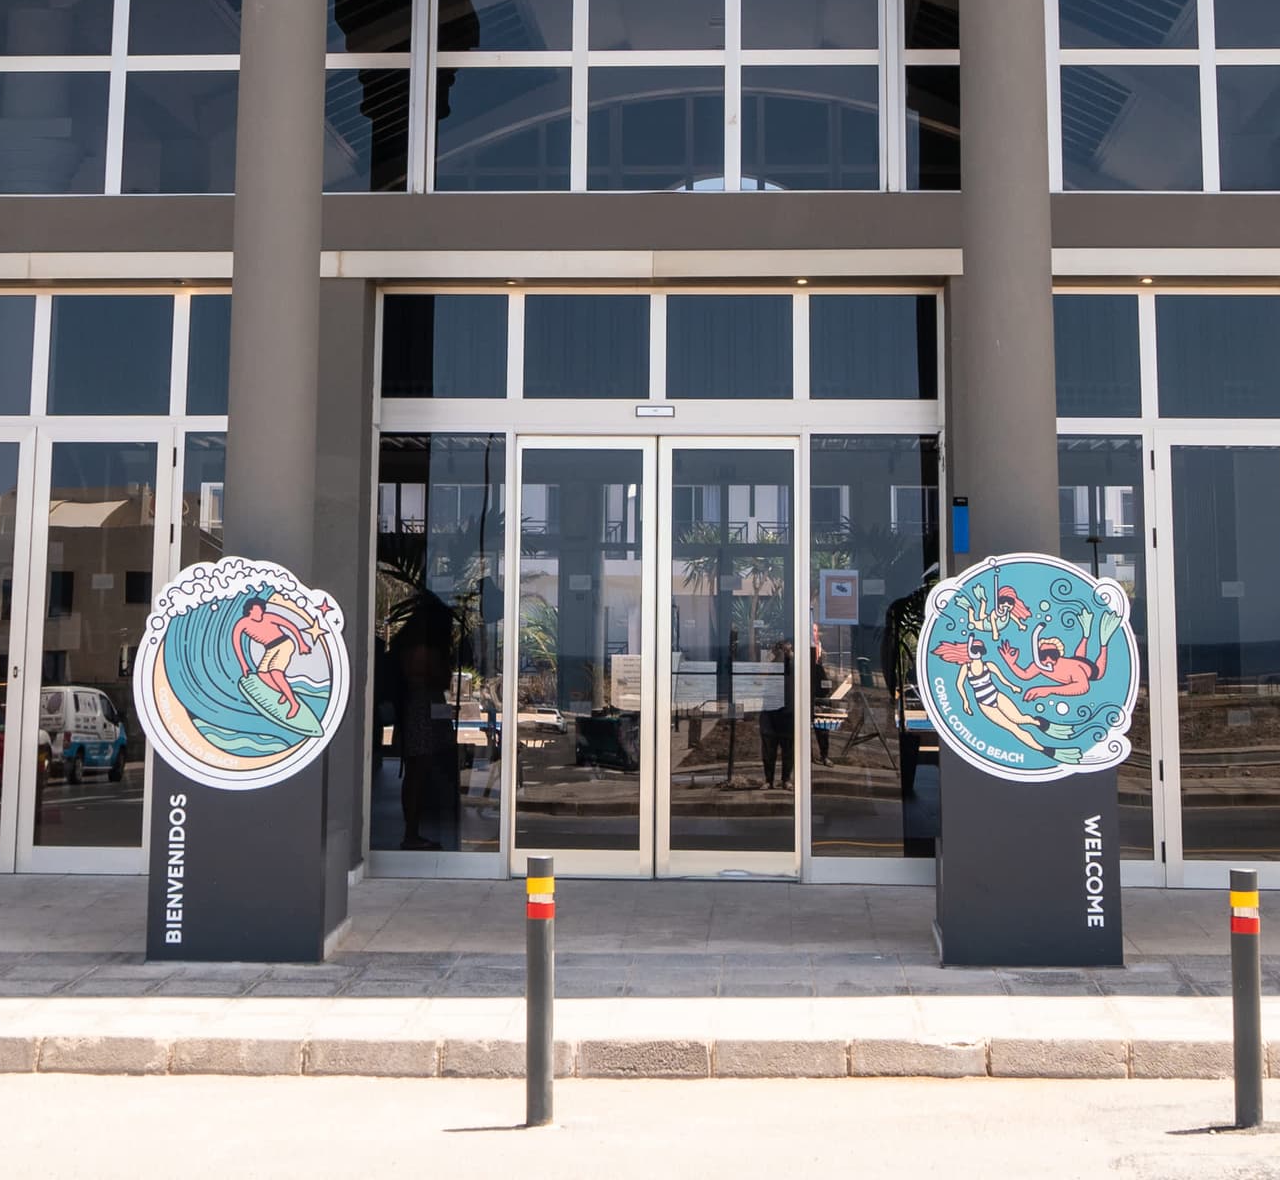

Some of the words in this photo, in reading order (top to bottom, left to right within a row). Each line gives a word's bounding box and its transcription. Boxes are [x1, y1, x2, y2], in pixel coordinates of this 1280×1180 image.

[933, 677, 953, 716] CORAL
[948, 715, 986, 752] COTILLO
[986, 746, 1025, 763] BEACH
[165, 793, 188, 944] BIENVENIDOS
[1083, 814, 1106, 928] WELCOME
